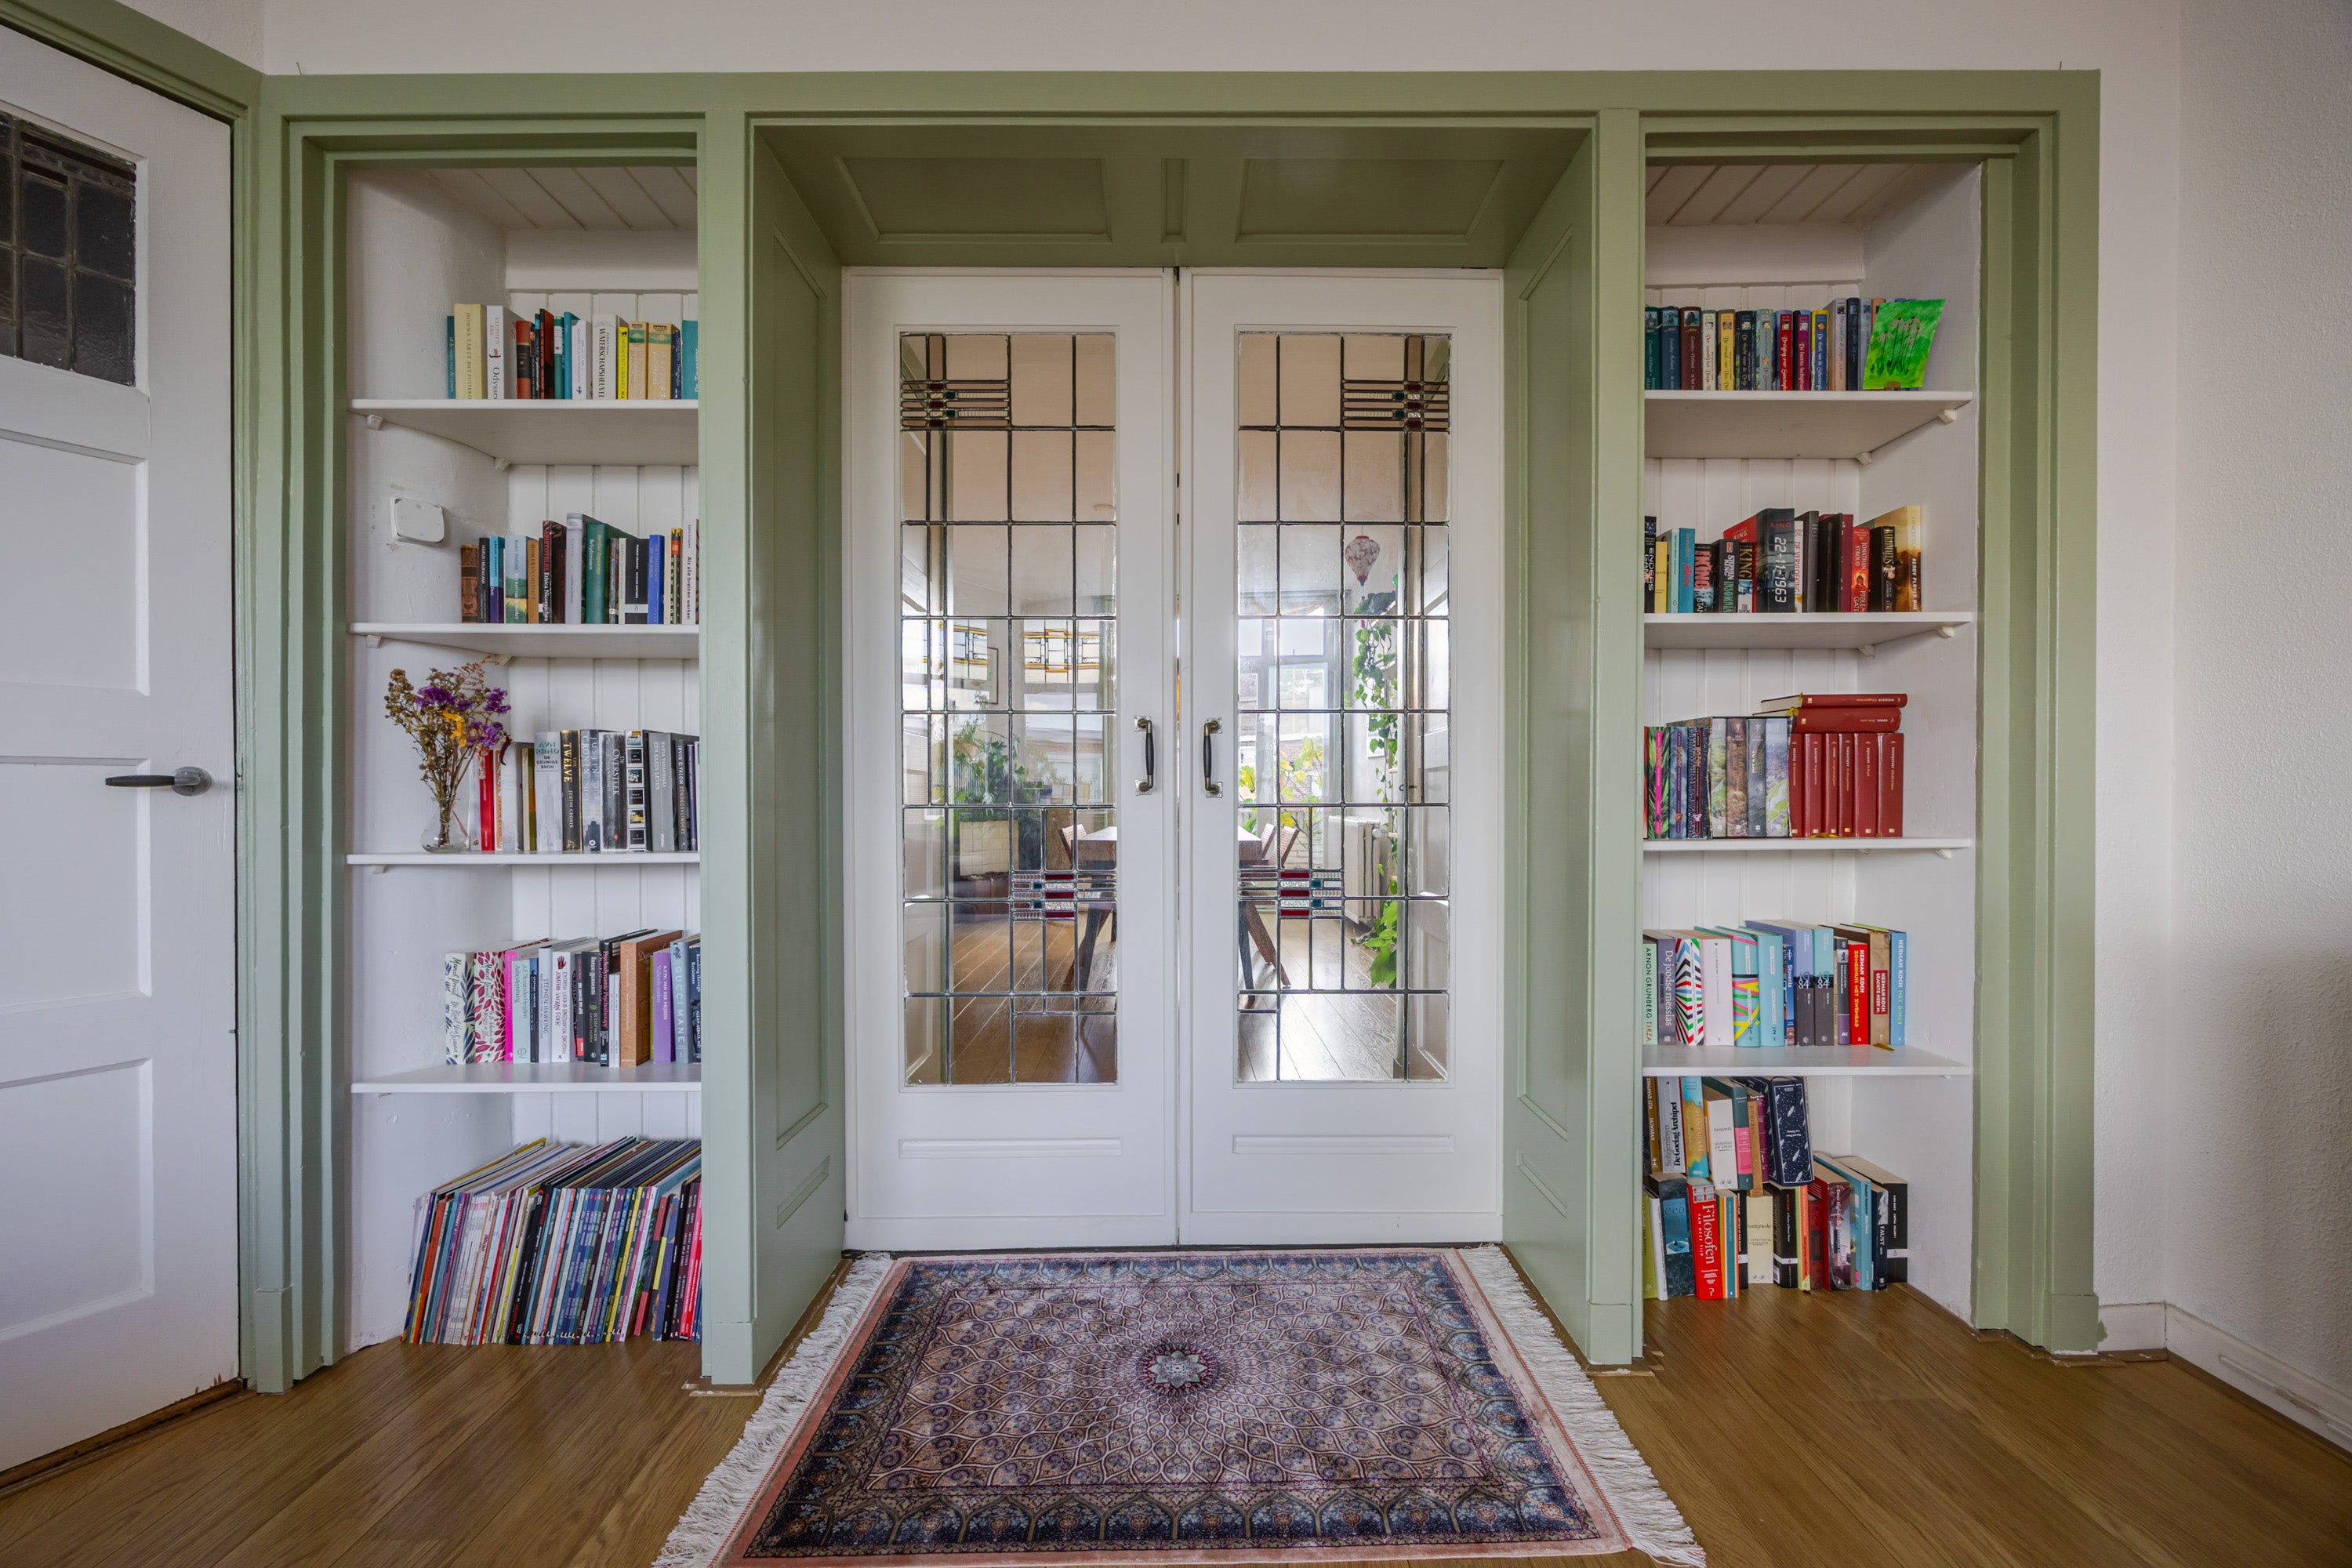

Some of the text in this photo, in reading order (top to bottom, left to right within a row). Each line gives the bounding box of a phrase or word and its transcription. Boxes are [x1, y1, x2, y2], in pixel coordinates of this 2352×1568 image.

[598, 328, 607, 397] WATERSCHAPSHEUVEL
[1882, 528, 1894, 564] BARTIMAEUS
[1694, 557, 1712, 590] KING
[1738, 548, 1753, 578] KING
[1774, 537, 1788, 602] 22-11-1963
[1722, 581, 1734, 613] INSOMNIA
[563, 742, 572, 782] TWELVE
[452, 957, 462, 977] Marcel
[485, 963, 493, 981] Marcel
[1663, 950, 1674, 1026] De joodse messias
[1798, 979, 1810, 989] 84
[1817, 979, 1830, 989] 84
[452, 1010, 462, 1024] Kant
[601, 992, 609, 1029] Psychotherapy
[1670, 1102, 1679, 1132] Archipel
[1673, 1156, 1681, 1167] De
[1702, 1204, 1717, 1265] Filosofen
